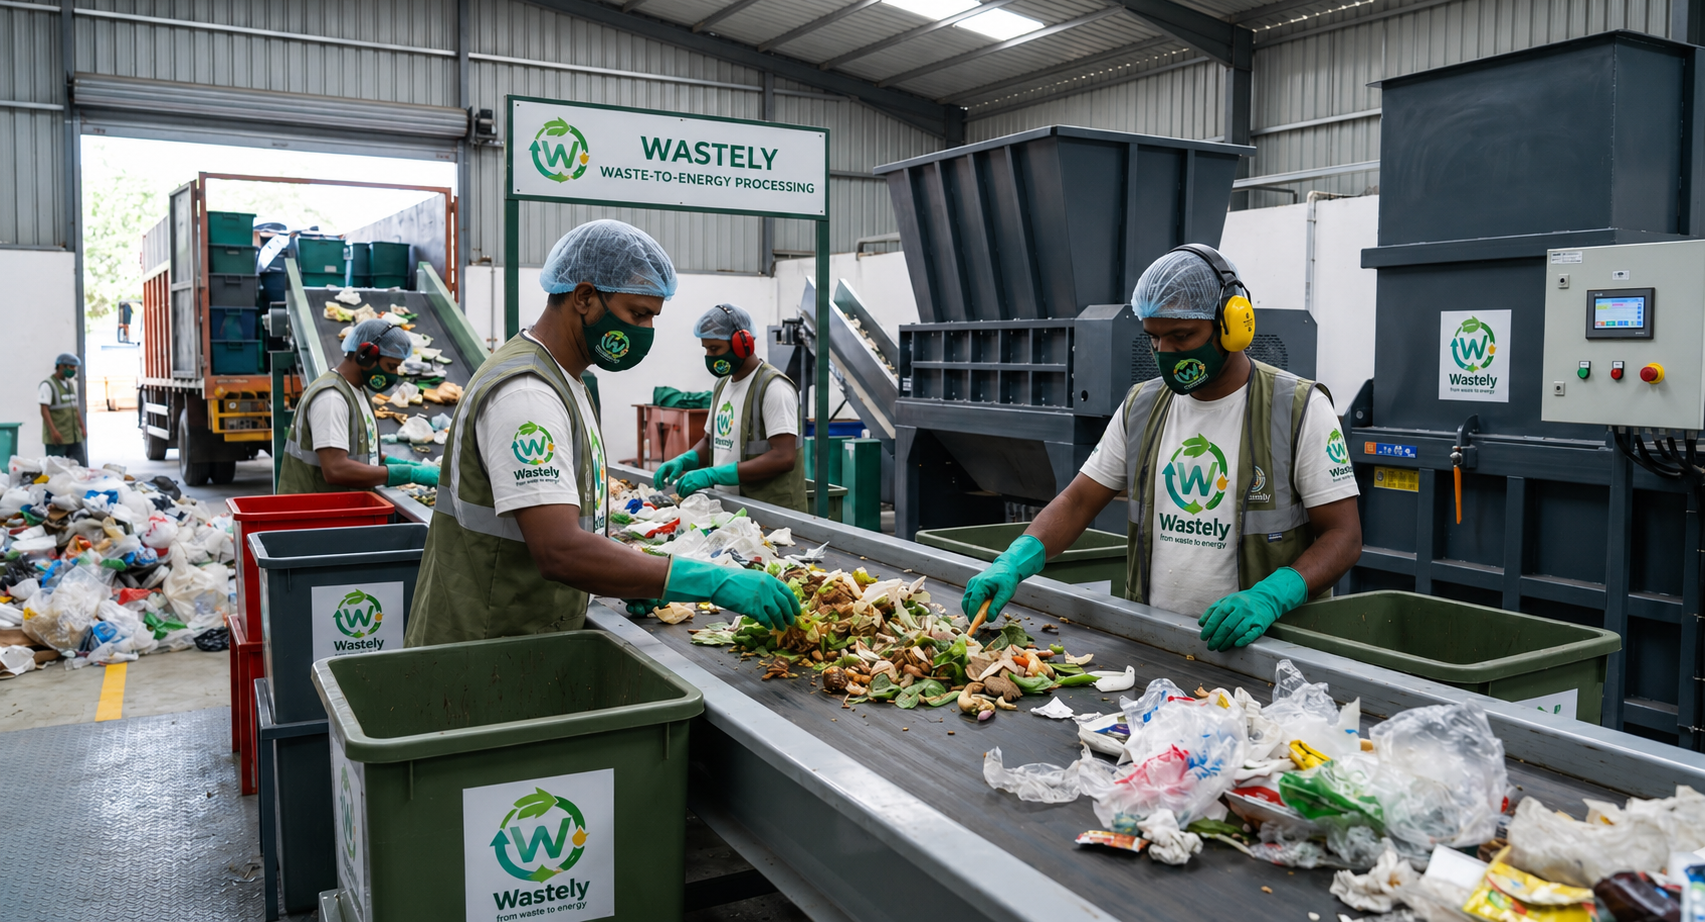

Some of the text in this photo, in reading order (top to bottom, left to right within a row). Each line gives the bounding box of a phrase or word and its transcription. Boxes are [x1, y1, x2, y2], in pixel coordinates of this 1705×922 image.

[541, 140, 579, 169] W
[641, 135, 779, 171] WASTELY
[600, 165, 815, 194] WASTE-TO-ENERGY PROCESSING
[1459, 335, 1488, 360] W
[1449, 373, 1498, 389] Wastely
[519, 435, 546, 456] W
[513, 465, 560, 480] Wastely
[1177, 461, 1219, 497] W
[1159, 512, 1232, 542] Wastely
[1201, 540, 1227, 550] energy
[343, 605, 374, 628] W
[333, 637, 385, 651] Wastely
[509, 817, 572, 864] W
[492, 878, 591, 911] Wastely
[496, 914, 518, 922] from
[519, 908, 545, 919] waste
[557, 901, 588, 912] energy
